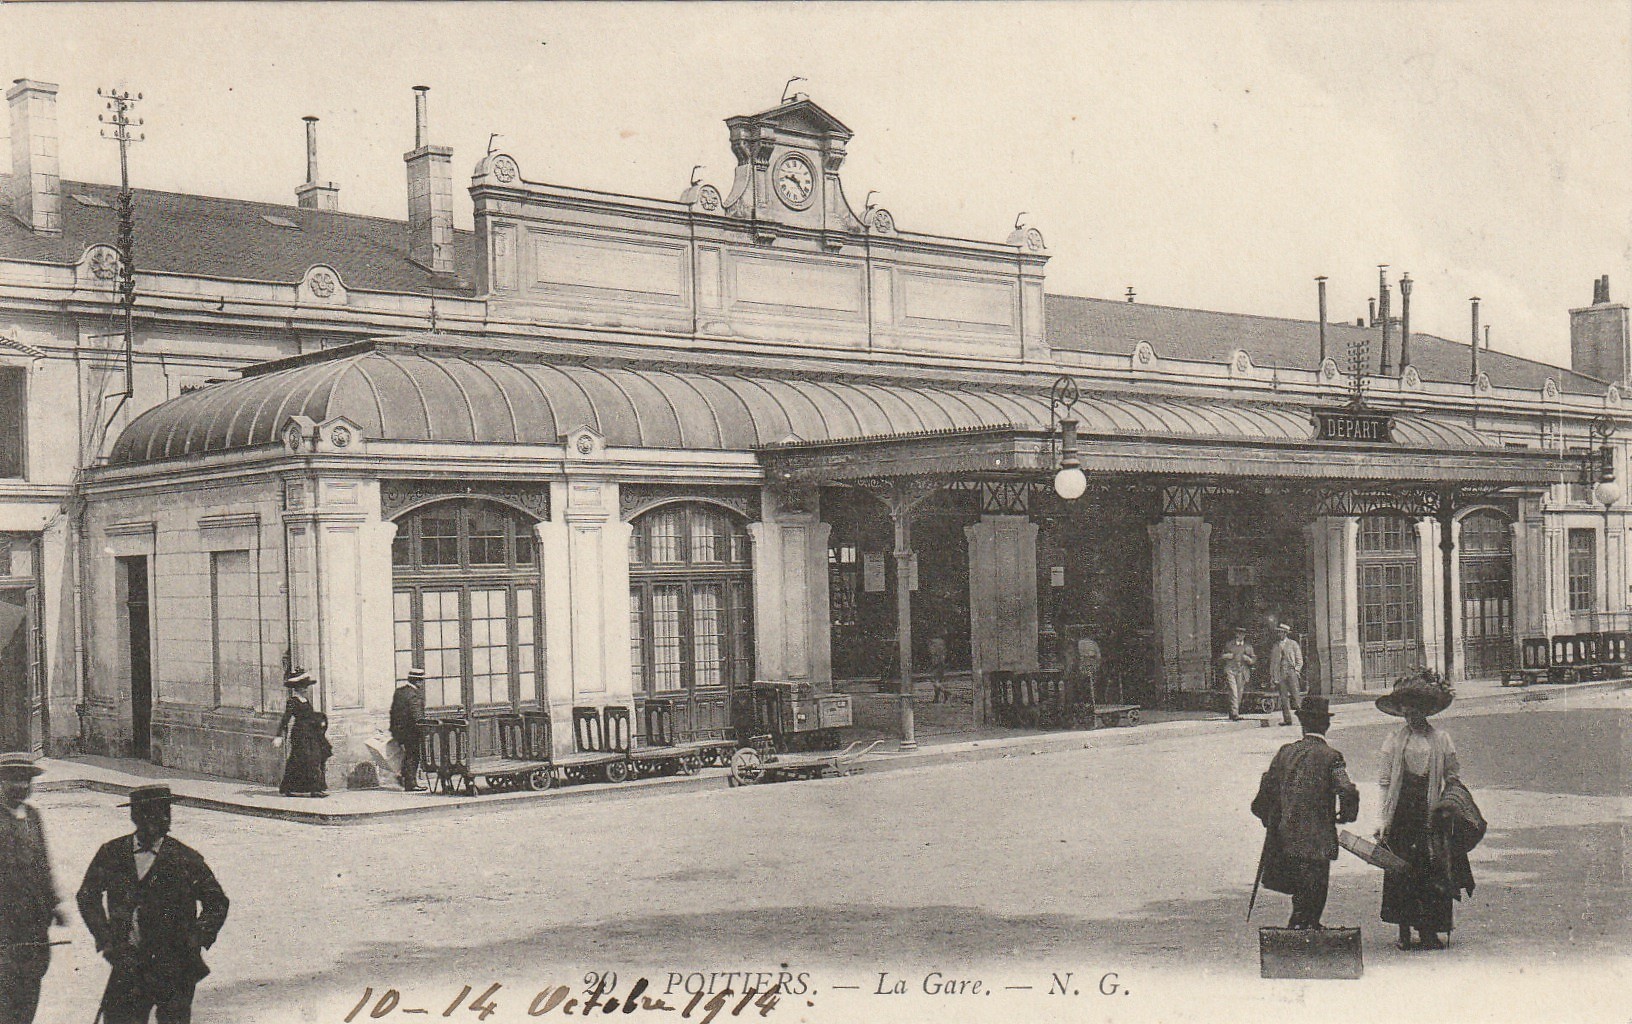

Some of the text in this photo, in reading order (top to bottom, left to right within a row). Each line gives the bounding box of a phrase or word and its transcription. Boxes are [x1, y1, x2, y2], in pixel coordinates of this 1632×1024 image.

[1327, 417, 1379, 439] DÉPART
[527, 977, 676, 1017] Octobre
[681, 983, 781, 1024] 1914
